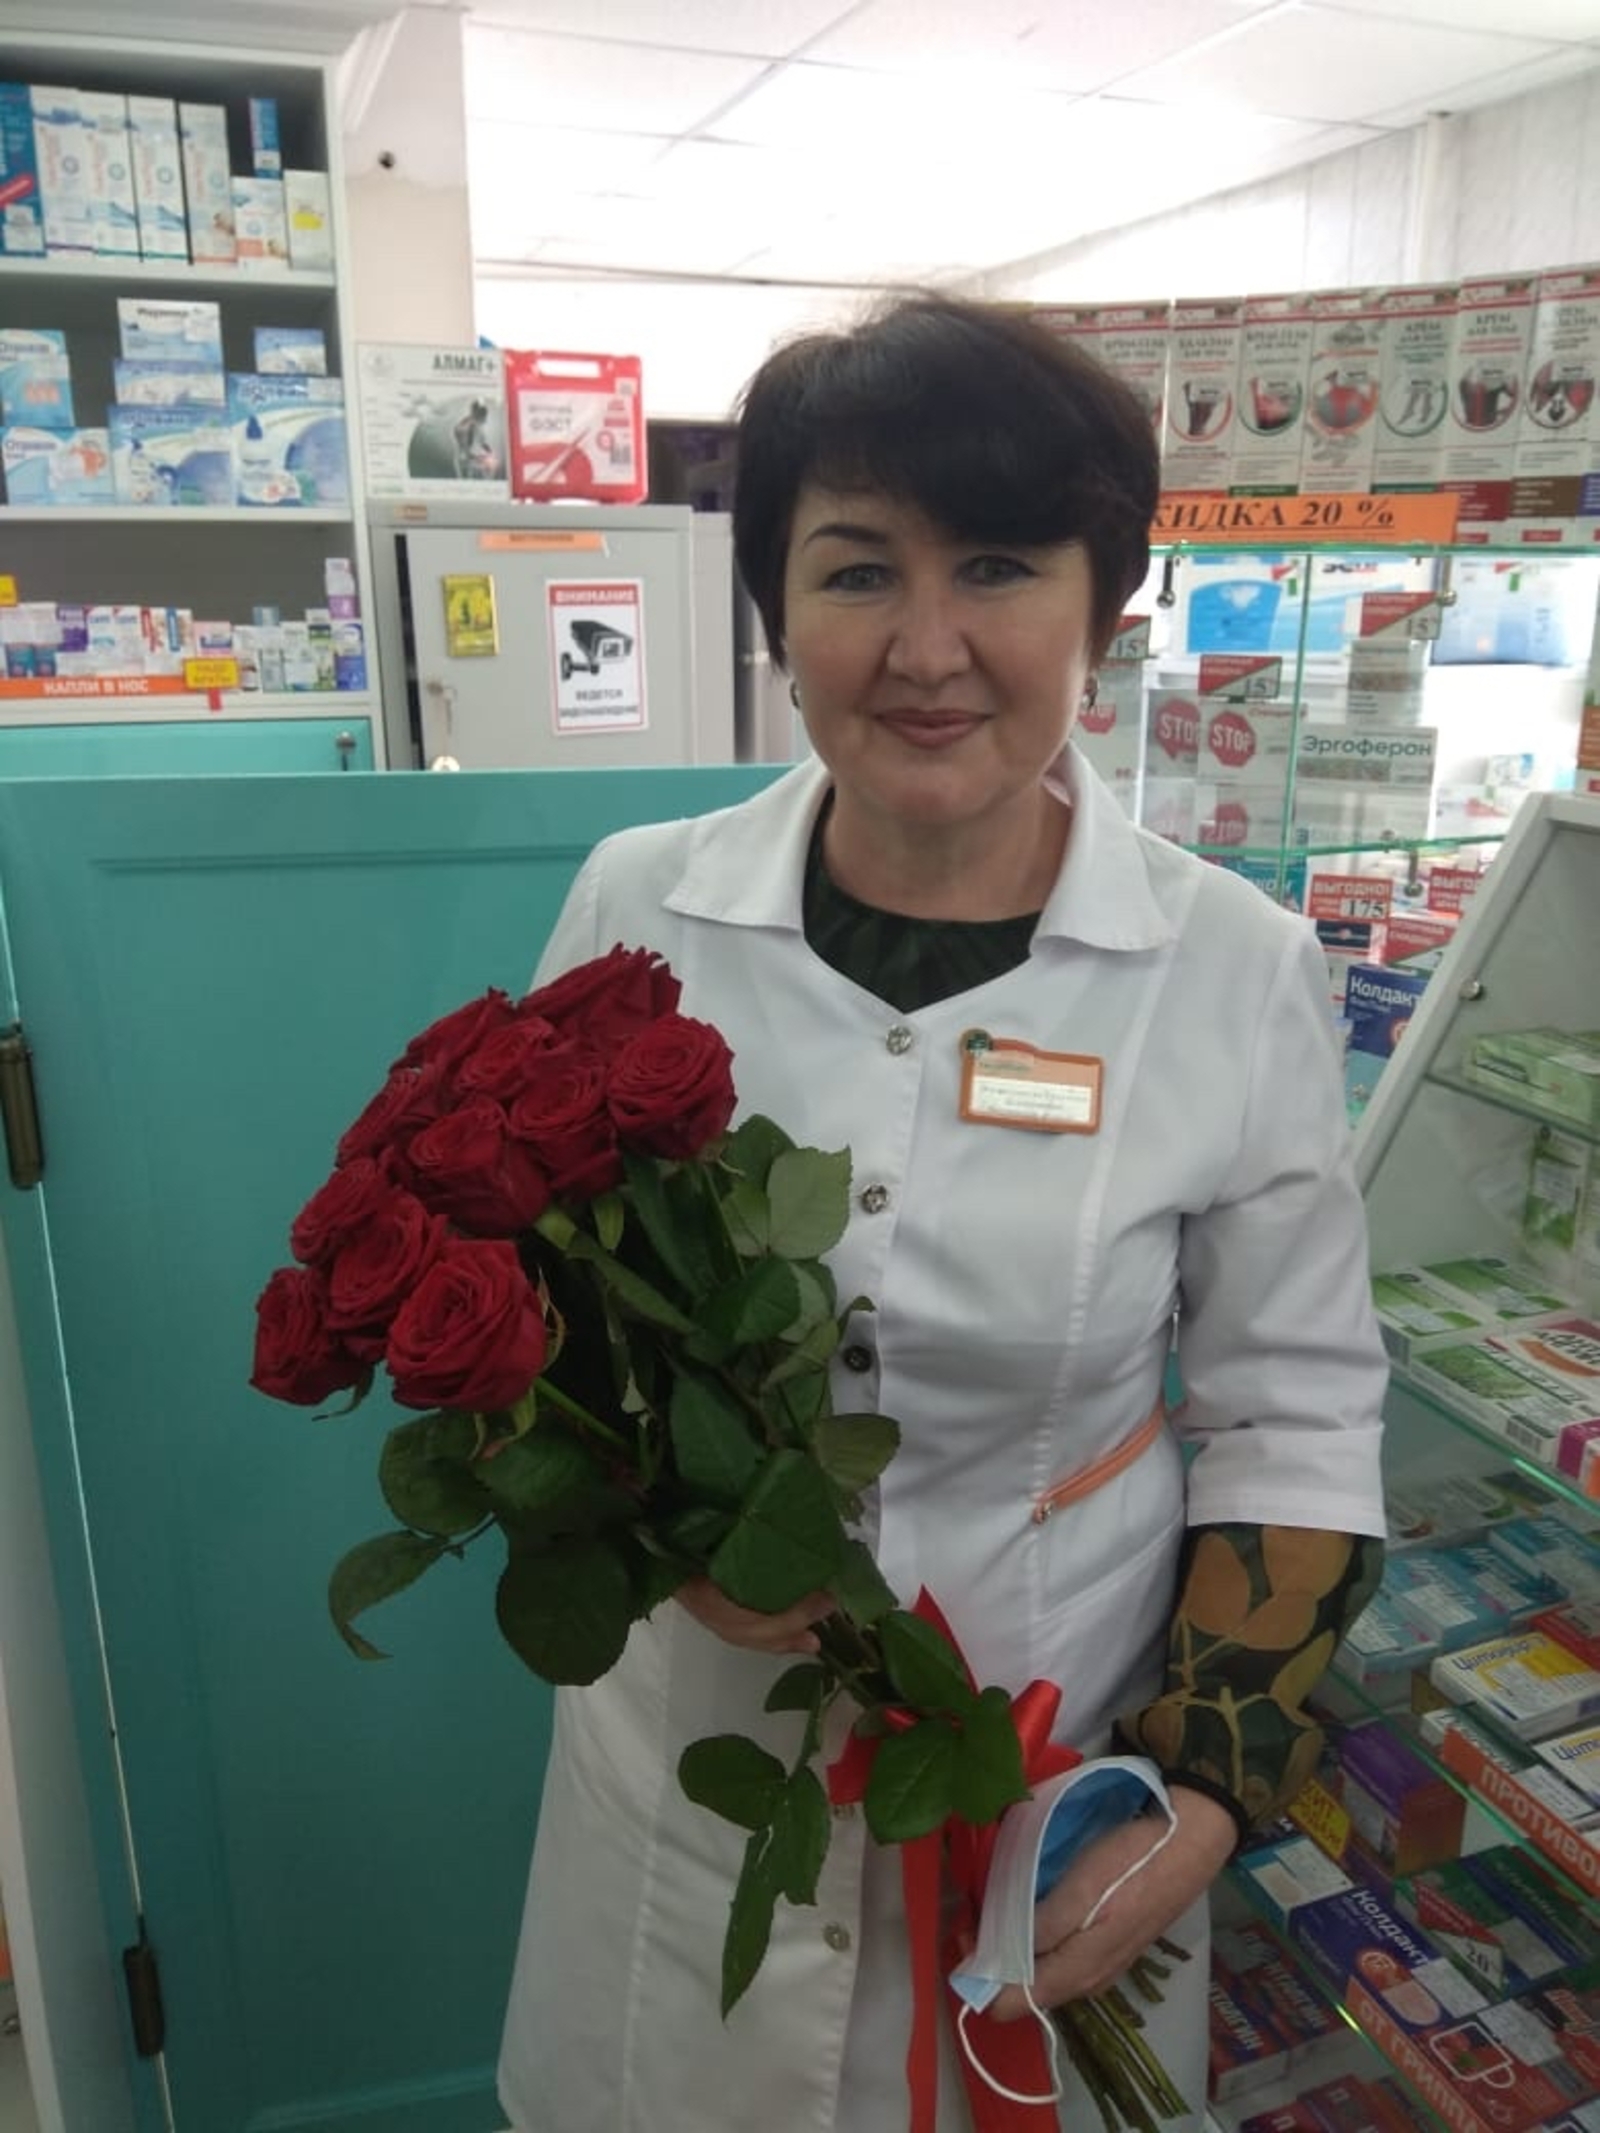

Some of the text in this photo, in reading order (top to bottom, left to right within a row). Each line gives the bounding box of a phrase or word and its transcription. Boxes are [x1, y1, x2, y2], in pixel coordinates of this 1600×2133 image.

[1300, 500, 1343, 527] 20
[1357, 500, 1395, 527] %
[555, 589, 635, 603] ВНИМАНИЕ
[44, 679, 149, 695] КАПЛИ В НОС
[1160, 713, 1200, 741] STO
[1211, 722, 1251, 755] STOP
[1302, 735, 1432, 758] Эргоферон
[1313, 882, 1390, 897] ВЫГОДНО!
[1481, 1763, 1600, 1888] ПРОТИВО
[1351, 1889, 1429, 1965] Колдакт
[1361, 2000, 1385, 2036] ОТ
